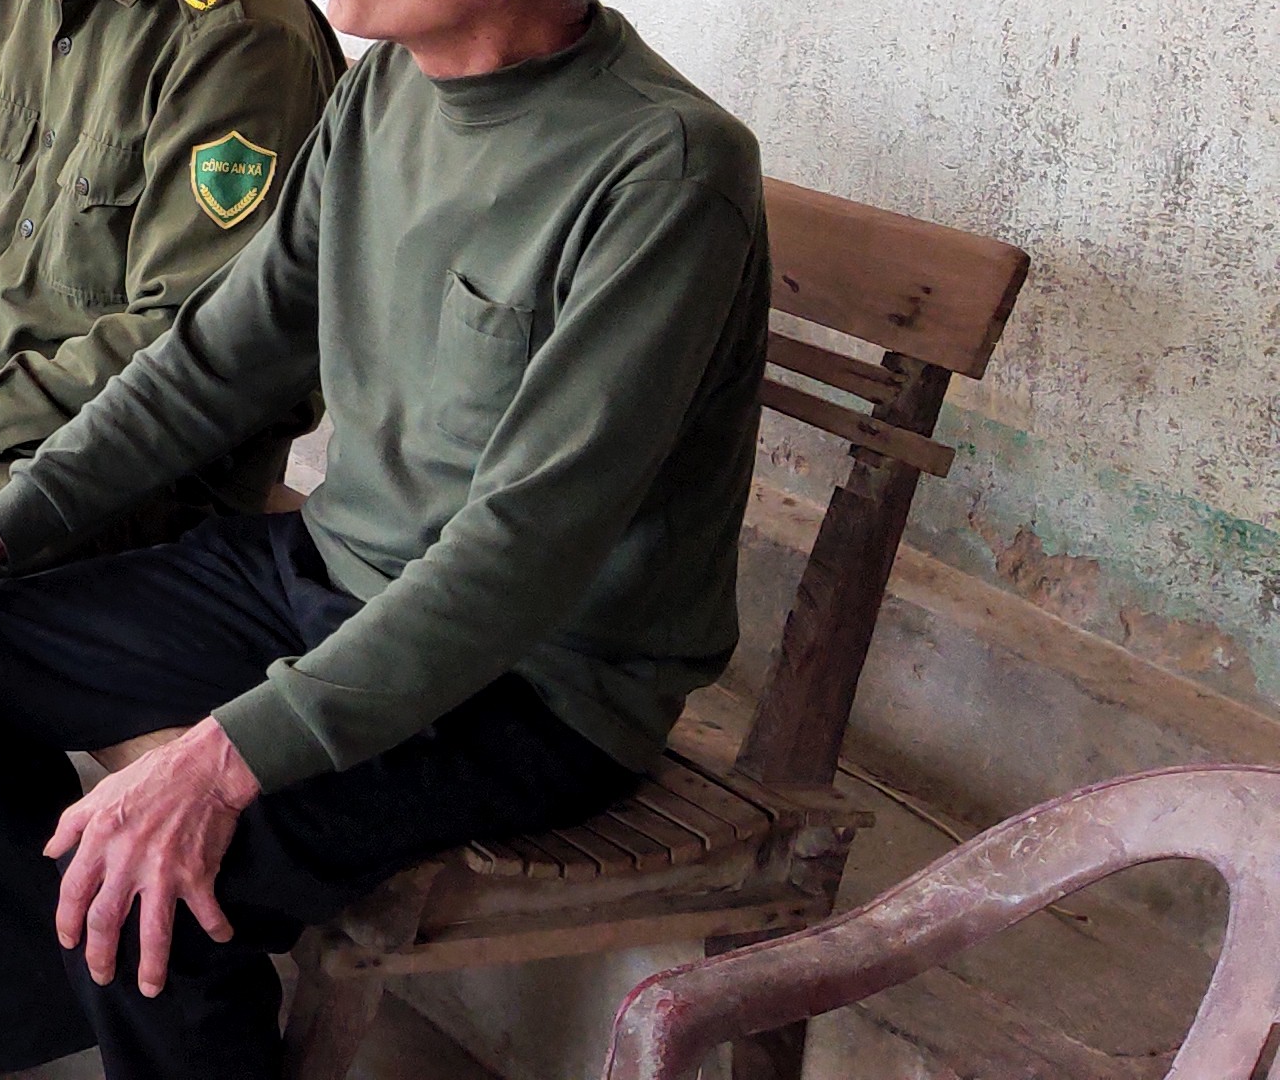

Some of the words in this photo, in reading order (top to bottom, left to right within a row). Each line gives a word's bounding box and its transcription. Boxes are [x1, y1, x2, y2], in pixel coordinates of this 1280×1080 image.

[202, 158, 229, 172] CÔNG
[231, 163, 245, 174] AN
[247, 163, 262, 176] XÃ
